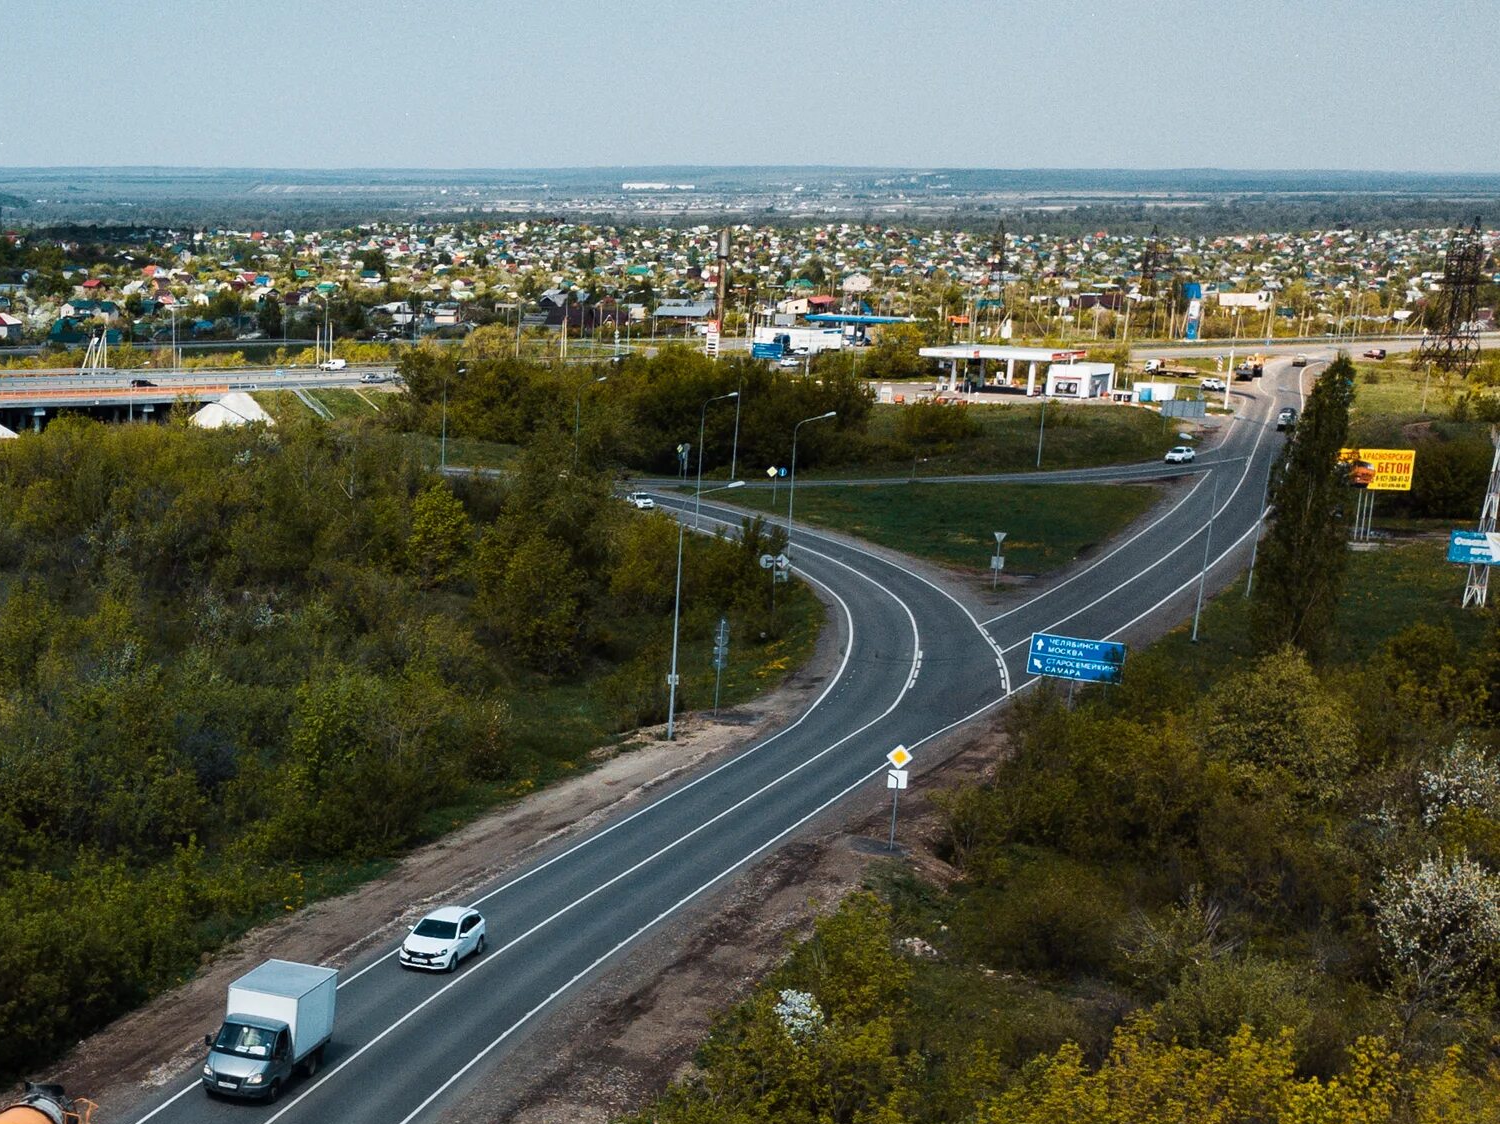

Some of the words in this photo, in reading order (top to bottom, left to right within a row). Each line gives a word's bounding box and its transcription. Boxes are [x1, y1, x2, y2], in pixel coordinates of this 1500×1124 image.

[1377, 462, 1410, 474] БЕТОН
[1049, 638, 1101, 651] ЧЕЛЯБИНСК
[1047, 647, 1084, 657] МОСКВА
[1044, 666, 1081, 677] САМАРА
